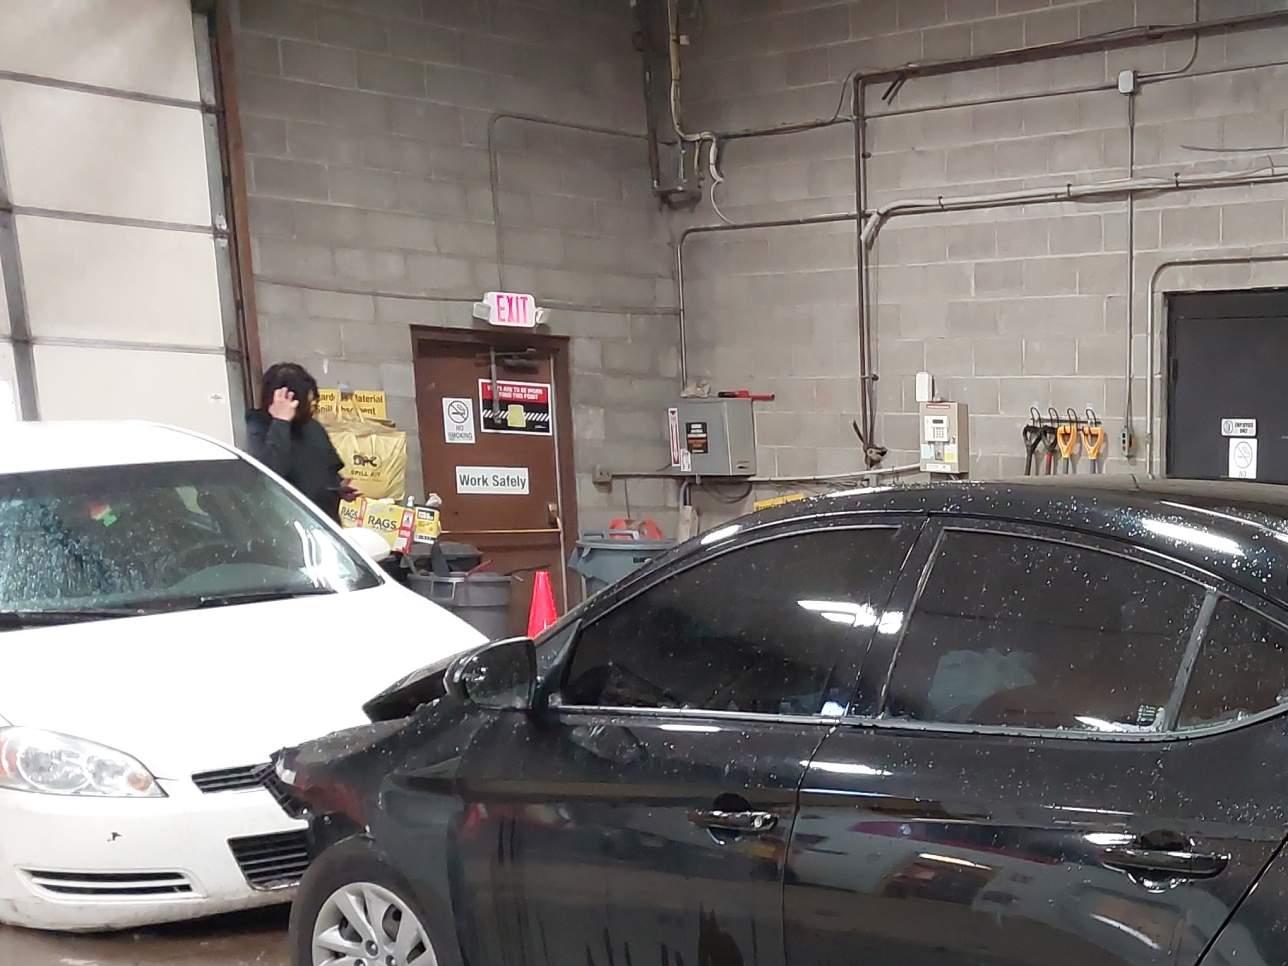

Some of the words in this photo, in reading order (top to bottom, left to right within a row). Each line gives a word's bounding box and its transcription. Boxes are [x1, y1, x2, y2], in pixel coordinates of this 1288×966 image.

[497, 295, 529, 321] EXIT
[455, 424, 465, 432] NO
[447, 432, 473, 440] SMOKING
[459, 474, 489, 487] Work
[492, 474, 527, 490] Safely
[367, 515, 397, 530] RAGS
